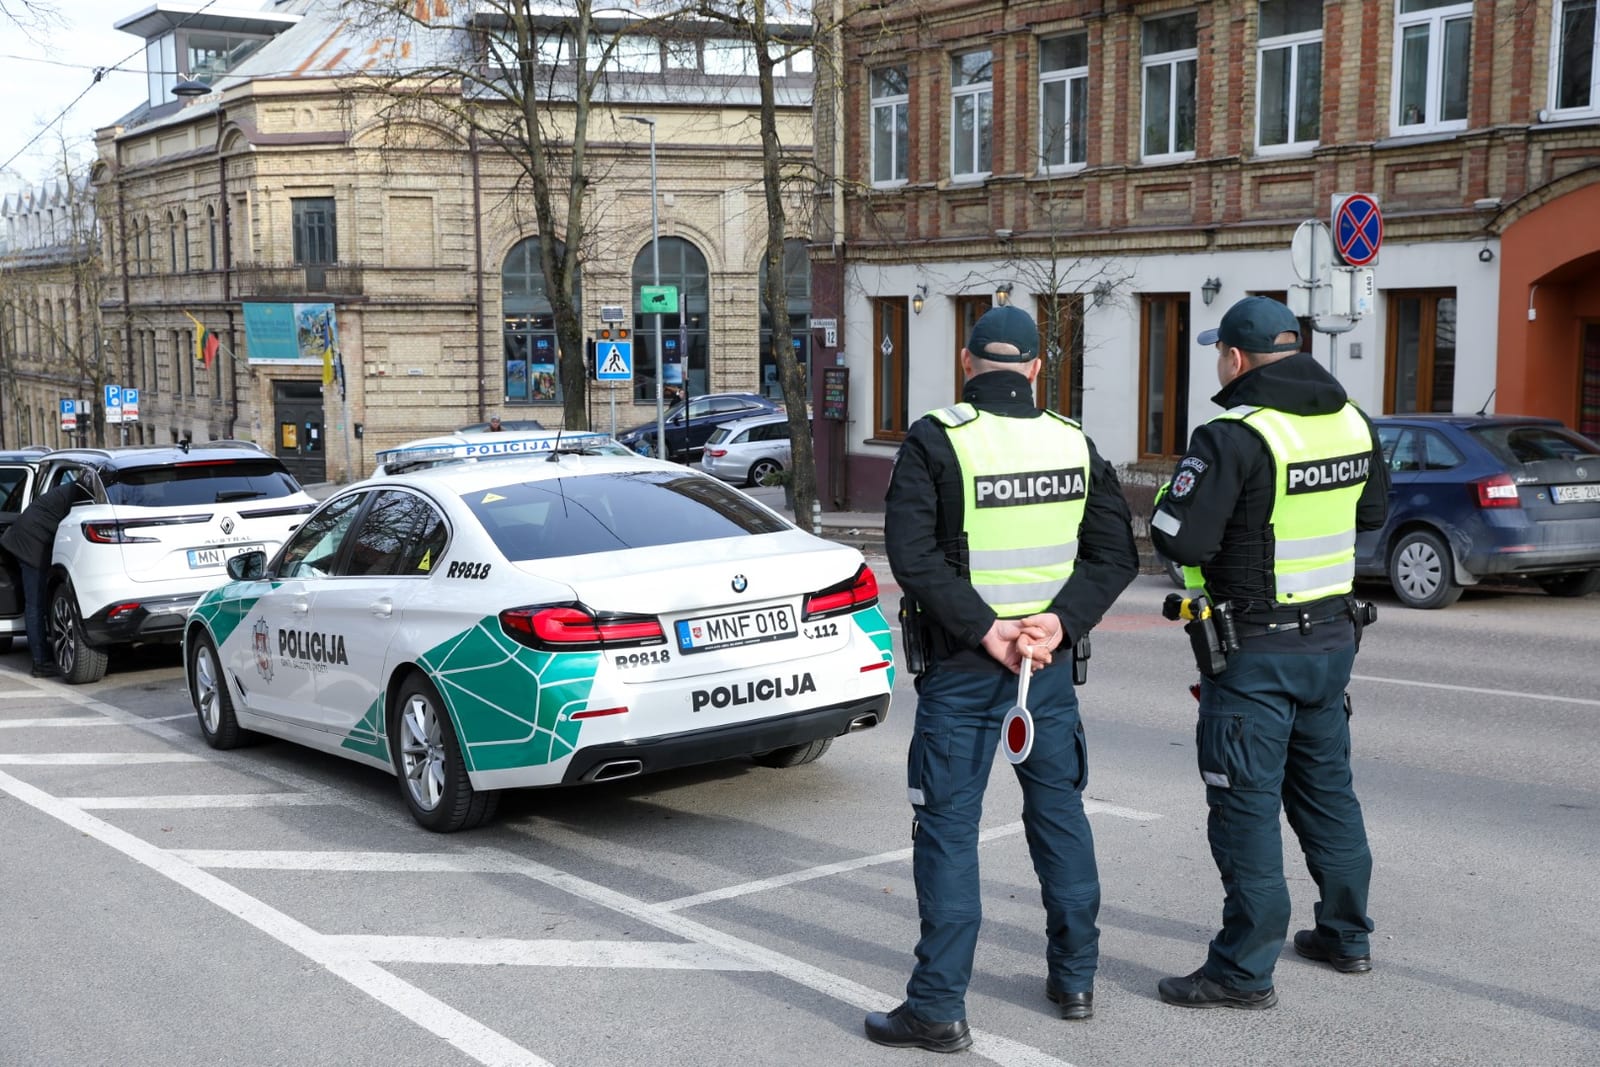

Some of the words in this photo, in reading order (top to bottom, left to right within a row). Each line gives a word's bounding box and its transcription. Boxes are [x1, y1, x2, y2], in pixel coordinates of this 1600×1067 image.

[827, 331, 836, 344] 12
[109, 387, 118, 398] P
[126, 390, 136, 402] P
[64, 401, 73, 413] P
[466, 440, 551, 456] POLICIJA
[1289, 458, 1370, 488] POLICIJA
[976, 473, 1085, 501] POLICIJA
[1558, 487, 1581, 499] KGE
[204, 535, 252, 544] AUSTRAL
[446, 561, 492, 580] R9818
[682, 637, 690, 645] LT
[705, 614, 751, 642] MNF
[755, 609, 789, 634] 018
[814, 623, 839, 639] 112
[278, 628, 349, 666] POLICIJA
[615, 649, 671, 670] R9818
[691, 672, 817, 713] POLICIJA
